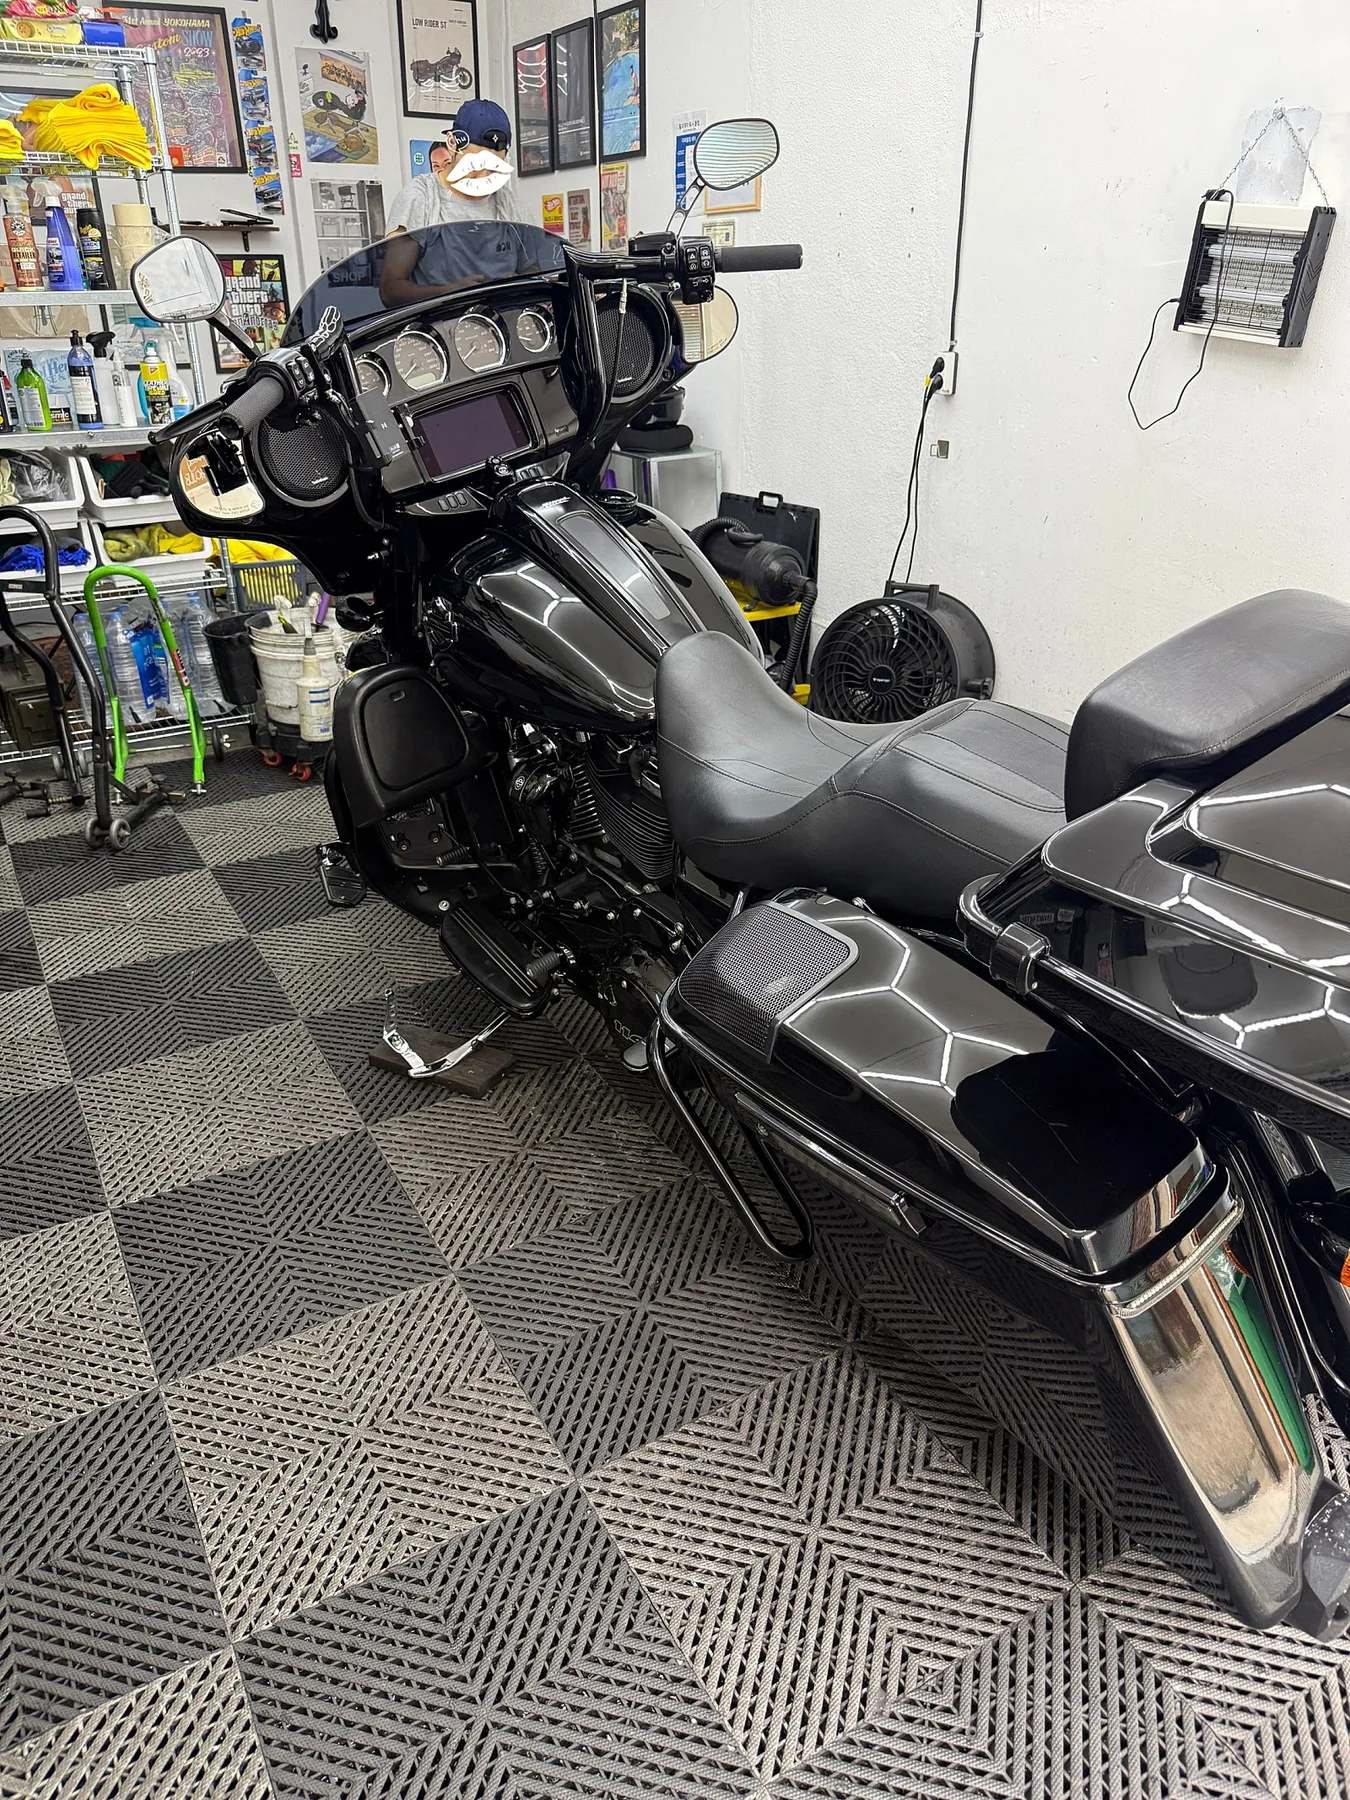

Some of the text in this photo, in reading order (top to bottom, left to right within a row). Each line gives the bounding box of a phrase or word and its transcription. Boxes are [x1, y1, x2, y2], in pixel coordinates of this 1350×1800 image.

[162, 18, 210, 28] YOKOHAMA
[411, 18, 424, 27] LOW
[424, 19, 440, 28] RIDER
[440, 21, 447, 29] ST
[180, 30, 214, 48] SHOW
[183, 46, 210, 58] 2023
[61, 192, 86, 201] grand
[66, 200, 94, 208] theft
[224, 274, 261, 292] grand
[332, 271, 367, 283] SHOP
[230, 290, 269, 304] theft
[242, 313, 278, 331] Andreas
